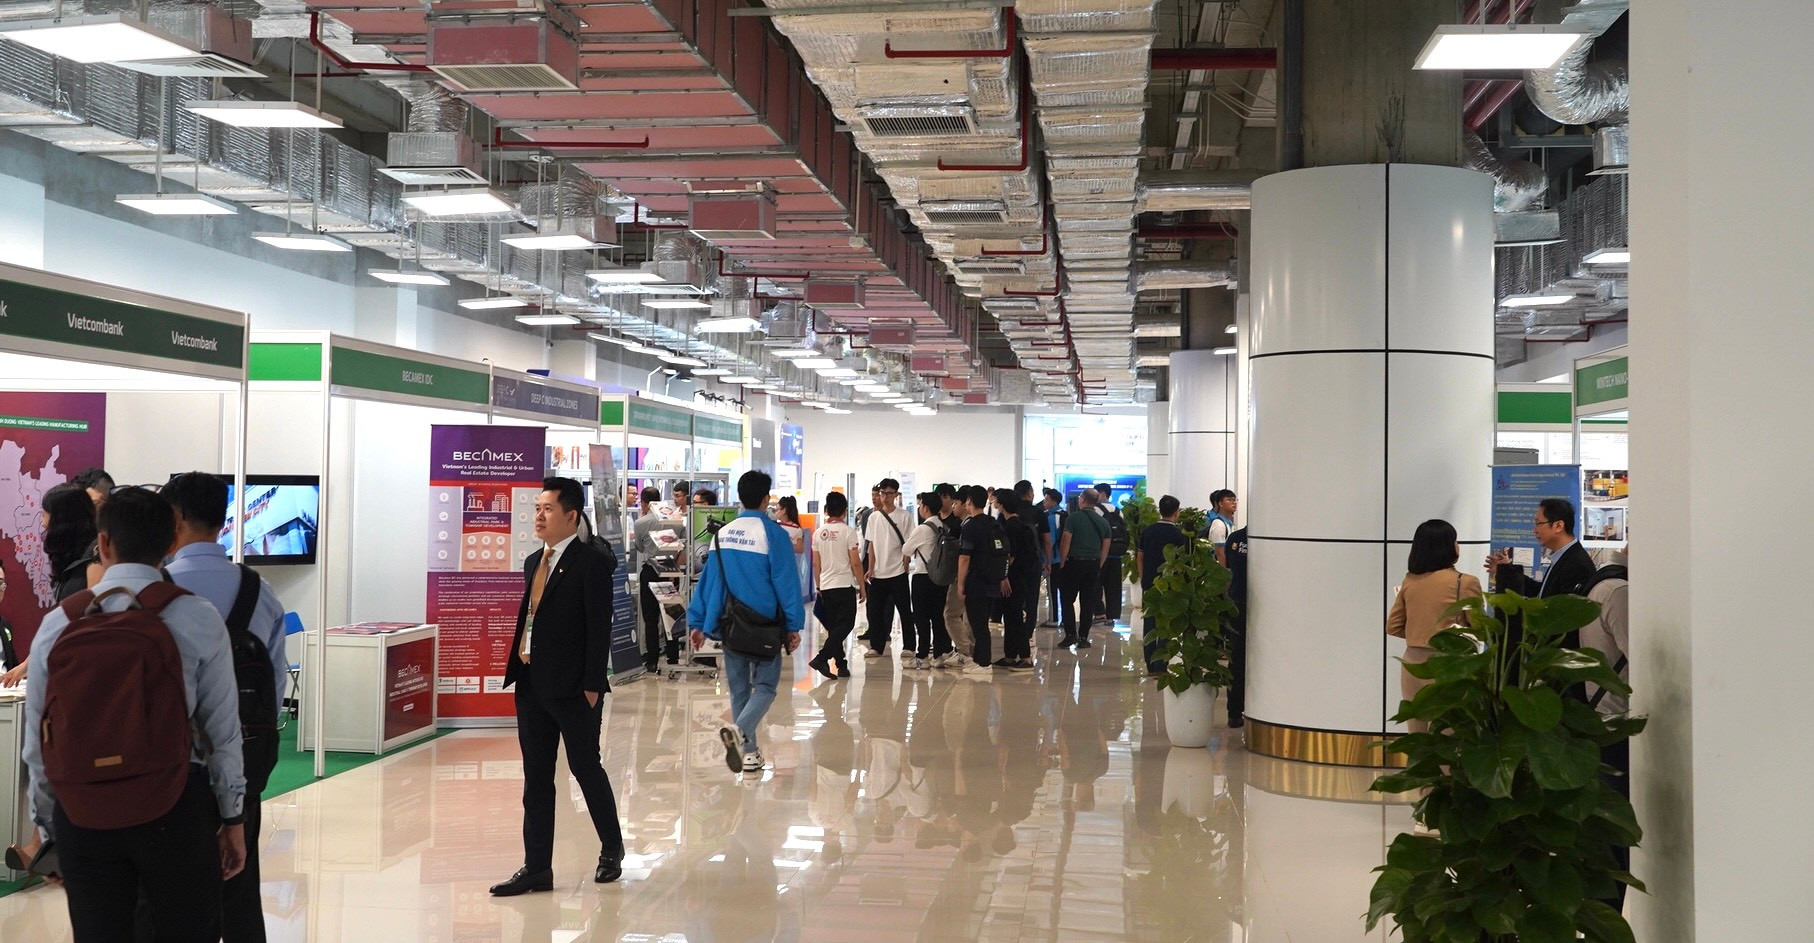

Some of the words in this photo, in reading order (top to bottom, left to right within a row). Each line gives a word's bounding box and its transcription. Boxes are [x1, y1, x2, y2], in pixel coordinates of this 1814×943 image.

[67, 312, 124, 337] Vietcombank
[171, 330, 218, 352] Vietcombank
[402, 370, 424, 384] BECAMEX
[424, 374, 433, 386] IDC
[531, 392, 541, 404] DEEP
[544, 395, 567, 409] INDUSTRIAL
[452, 448, 524, 462] BECAMEX
